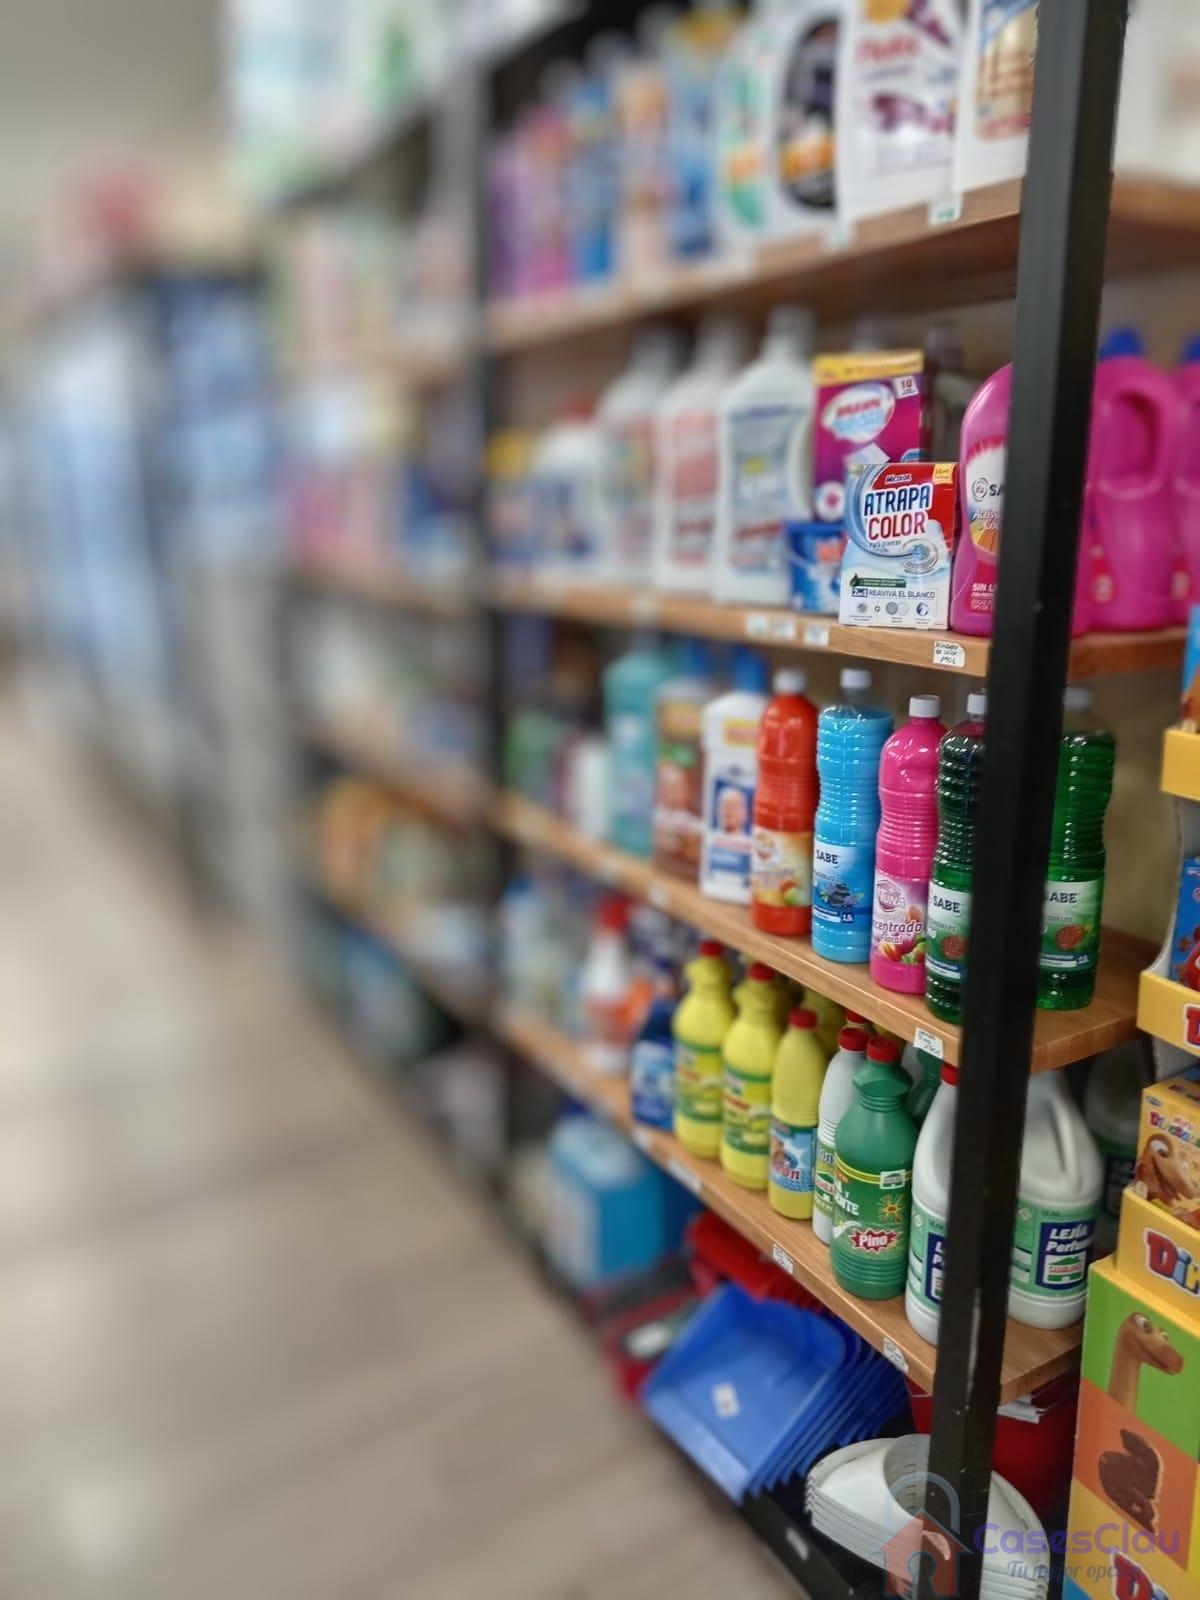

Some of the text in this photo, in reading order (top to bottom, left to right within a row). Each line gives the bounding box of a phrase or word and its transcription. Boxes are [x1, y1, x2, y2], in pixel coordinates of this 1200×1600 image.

[864, 485, 931, 517] ATRAPA
[868, 512, 926, 541] COLOR
[907, 591, 936, 599] BLANCO
[933, 895, 961, 914] SABE
[859, 1234, 888, 1247] Pino
